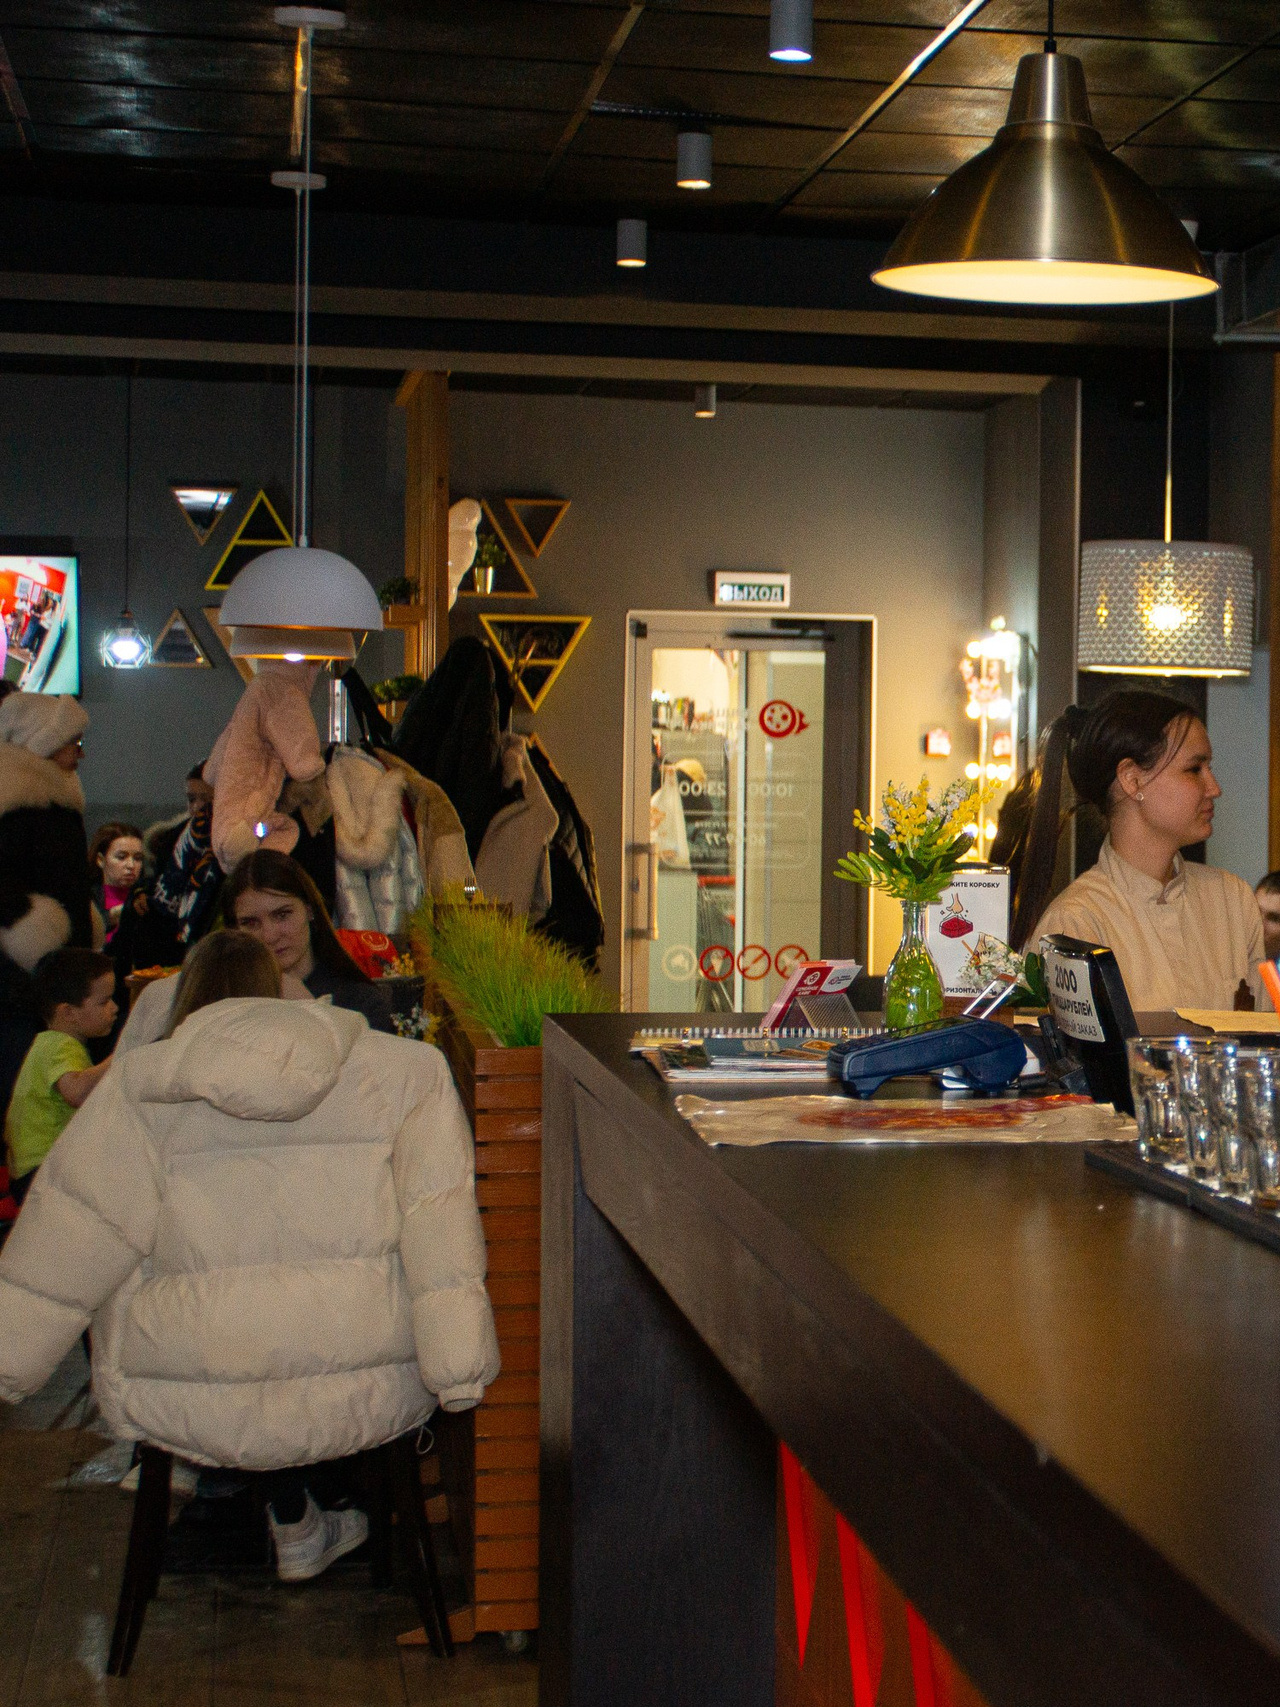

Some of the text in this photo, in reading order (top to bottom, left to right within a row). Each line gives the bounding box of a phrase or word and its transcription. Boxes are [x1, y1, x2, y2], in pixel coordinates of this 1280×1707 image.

[969, 881, 1001, 889] КОРОБКУ
[1055, 964, 1078, 994] 2000
[1077, 1022, 1098, 1037] ЗАКАЗ
